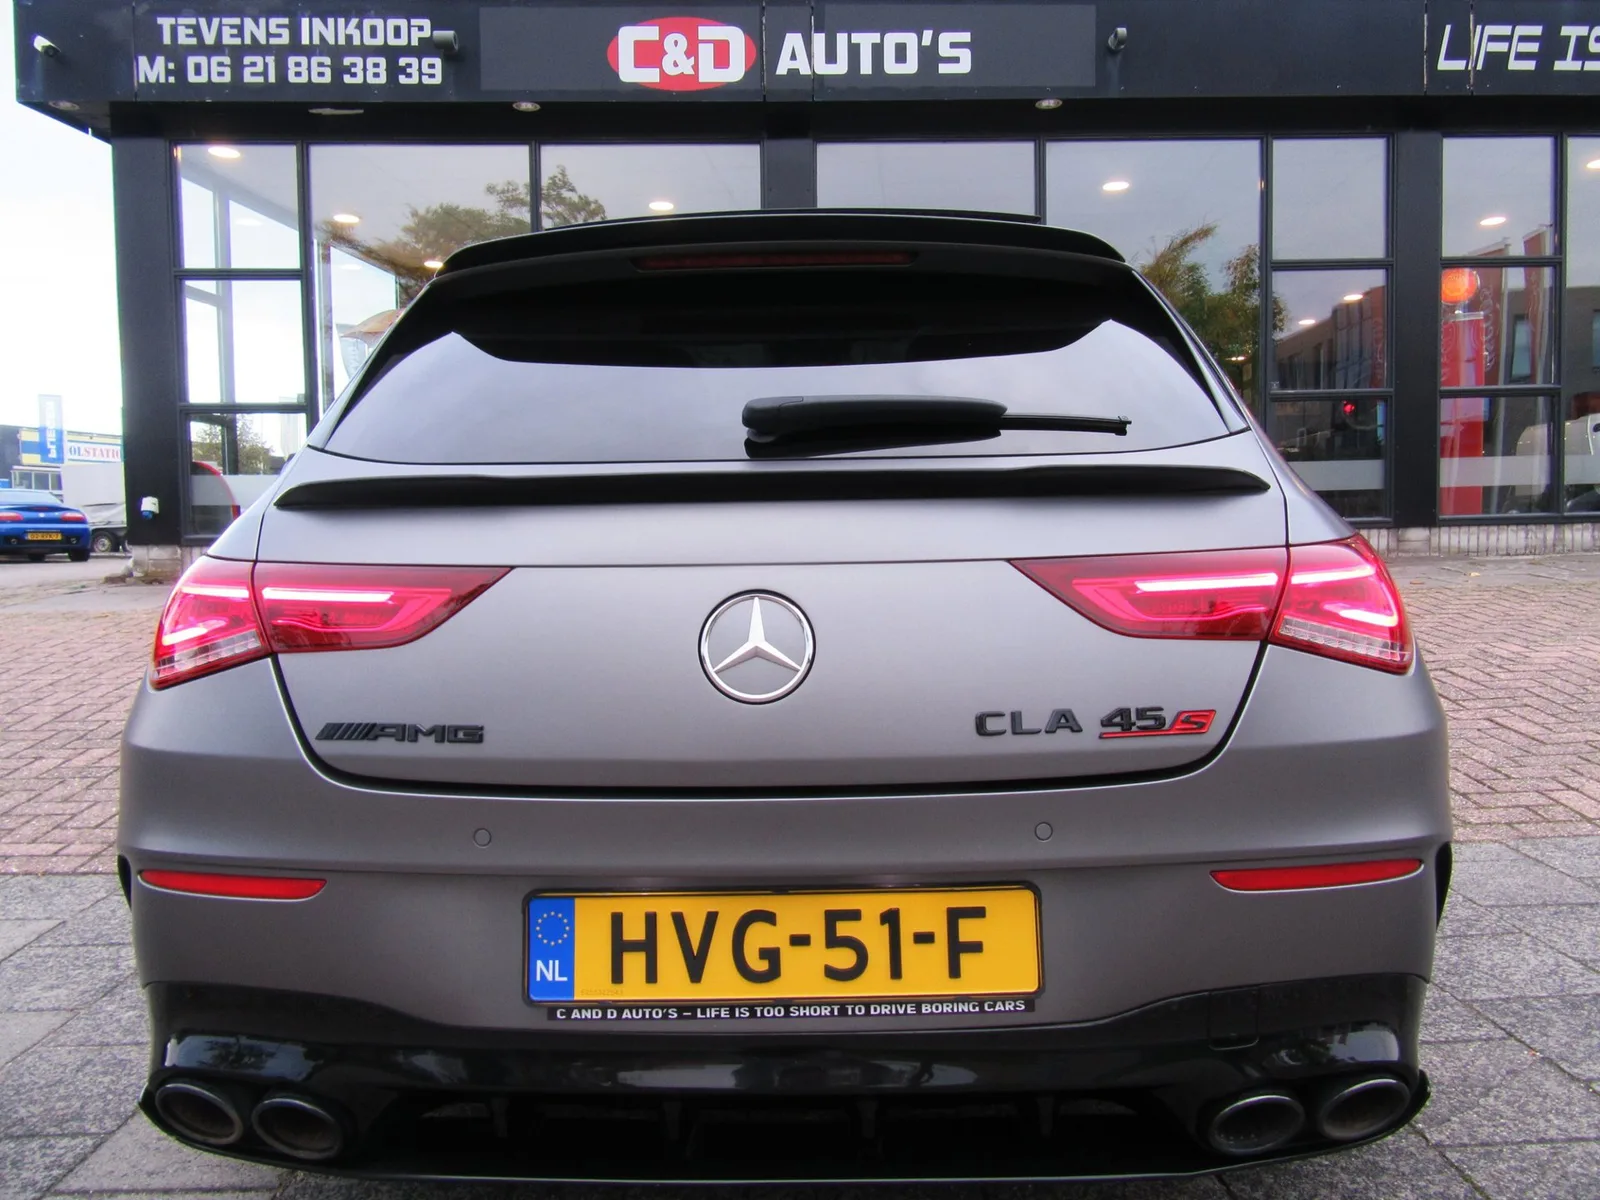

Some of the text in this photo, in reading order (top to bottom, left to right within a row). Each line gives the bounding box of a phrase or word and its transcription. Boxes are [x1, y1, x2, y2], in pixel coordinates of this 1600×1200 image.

[156, 17, 431, 46] TEVENS INKOOP
[618, 26, 972, 83] C&D AUTO'S
[1437, 24, 1543, 70] LIFE
[138, 56, 442, 84] M: 06 21 86 38 39
[975, 708, 1083, 736] CLA
[609, 906, 987, 984] HVG-51-F
[535, 959, 568, 982] NL
[556, 1008, 567, 1019] C
[571, 1008, 602, 1019] AND
[606, 1008, 618, 1019] D
[621, 1008, 678, 1019] AUTO'S
[696, 1007, 731, 1018] LIFE
[735, 1007, 750, 1018] IS
[754, 1006, 785, 1017] TOO
[789, 1005, 841, 1017] SHORT
[845, 1004, 866, 1015] TO
[870, 1003, 917, 1015] DRIVE
[921, 1002, 980, 1014] BORING
[984, 1000, 1026, 1012] CARS
